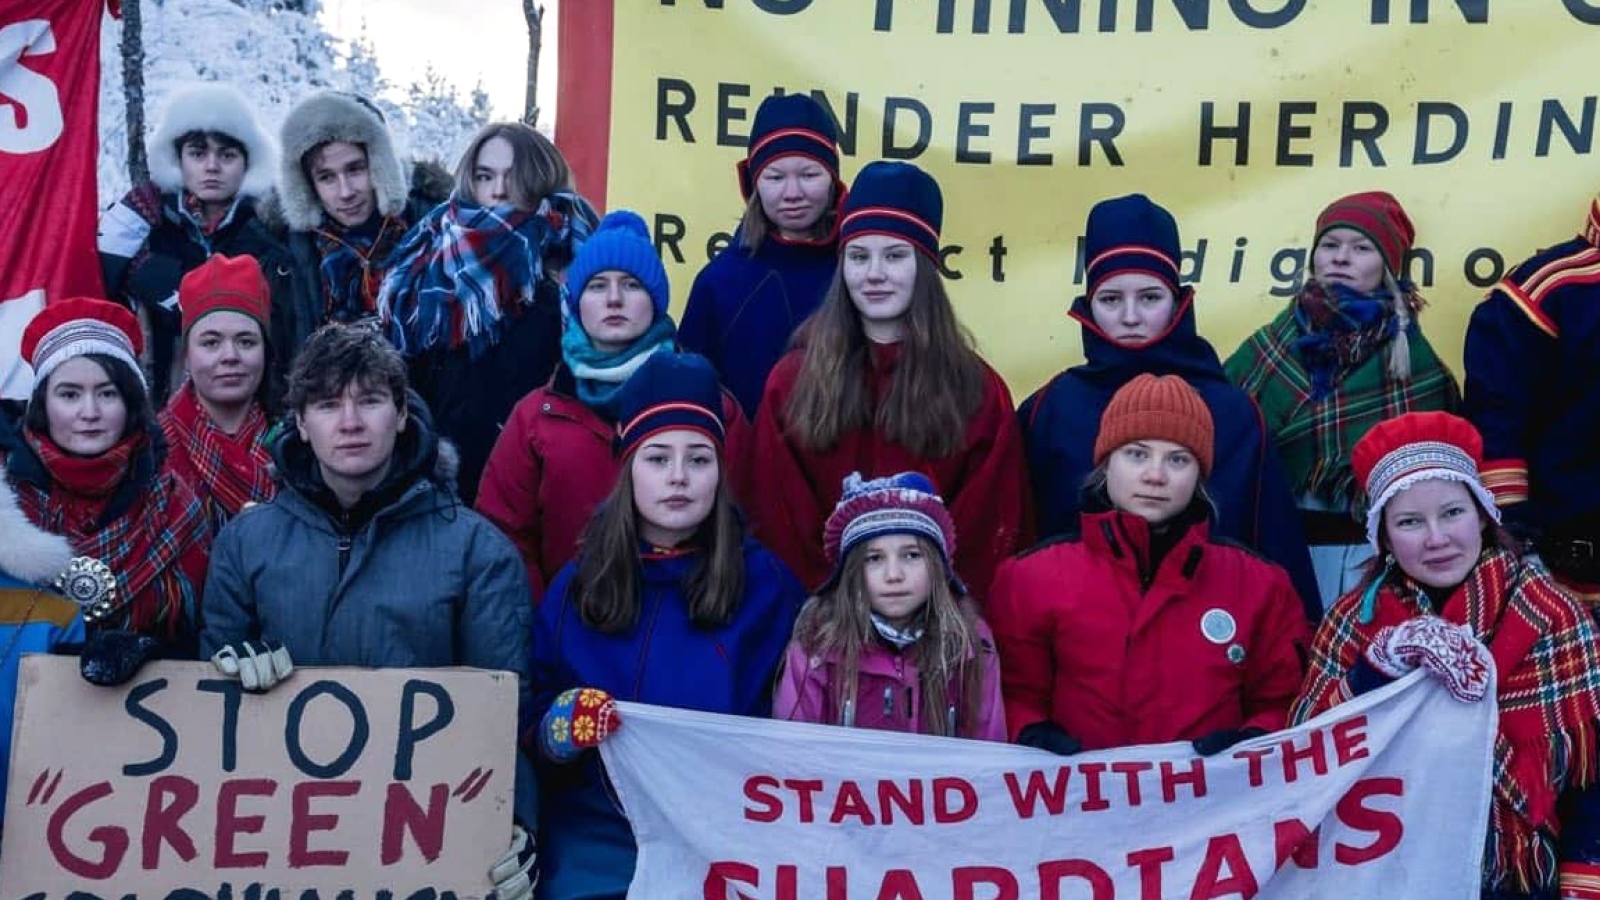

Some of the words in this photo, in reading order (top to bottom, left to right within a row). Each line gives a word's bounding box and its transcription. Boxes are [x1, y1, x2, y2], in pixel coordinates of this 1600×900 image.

[655, 77, 1125, 167] RENDEER
[1198, 95, 1600, 168] HERDIN
[653, 213, 1008, 283] Rect
[1073, 235, 1548, 297] Idigno
[121, 678, 455, 781] STOP
[743, 775, 979, 826] STAND
[1003, 758, 1208, 819] WITH
[1233, 714, 1370, 788] THE
[26, 767, 494, 880] "GREEN"
